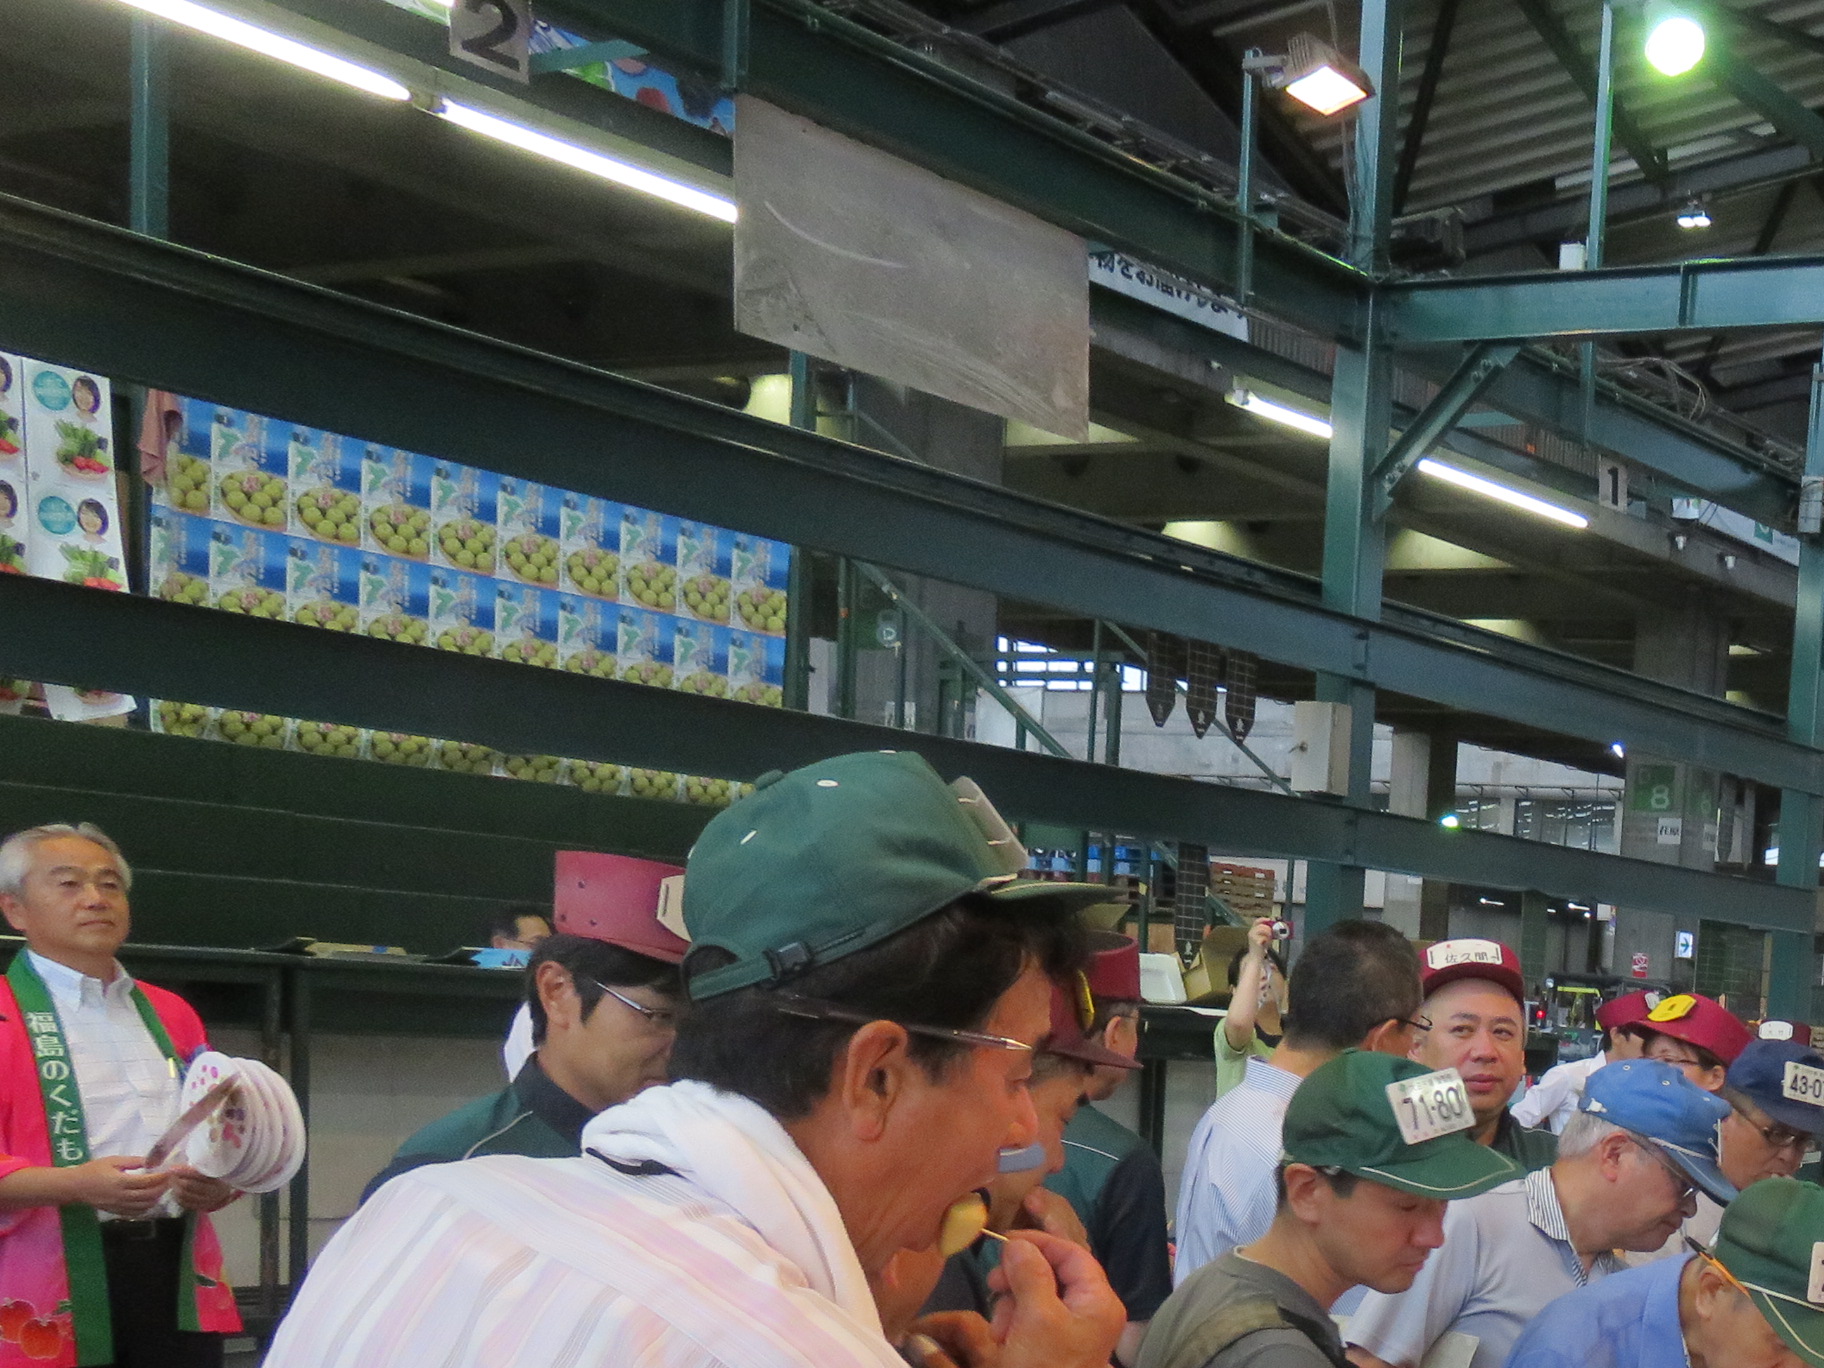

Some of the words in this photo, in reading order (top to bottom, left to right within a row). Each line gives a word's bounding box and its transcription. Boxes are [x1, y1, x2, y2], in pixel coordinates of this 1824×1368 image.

[462, 0, 520, 72] 2
[1608, 466, 1619, 506] 1
[26, 1011, 84, 1168] 福島のくだも
